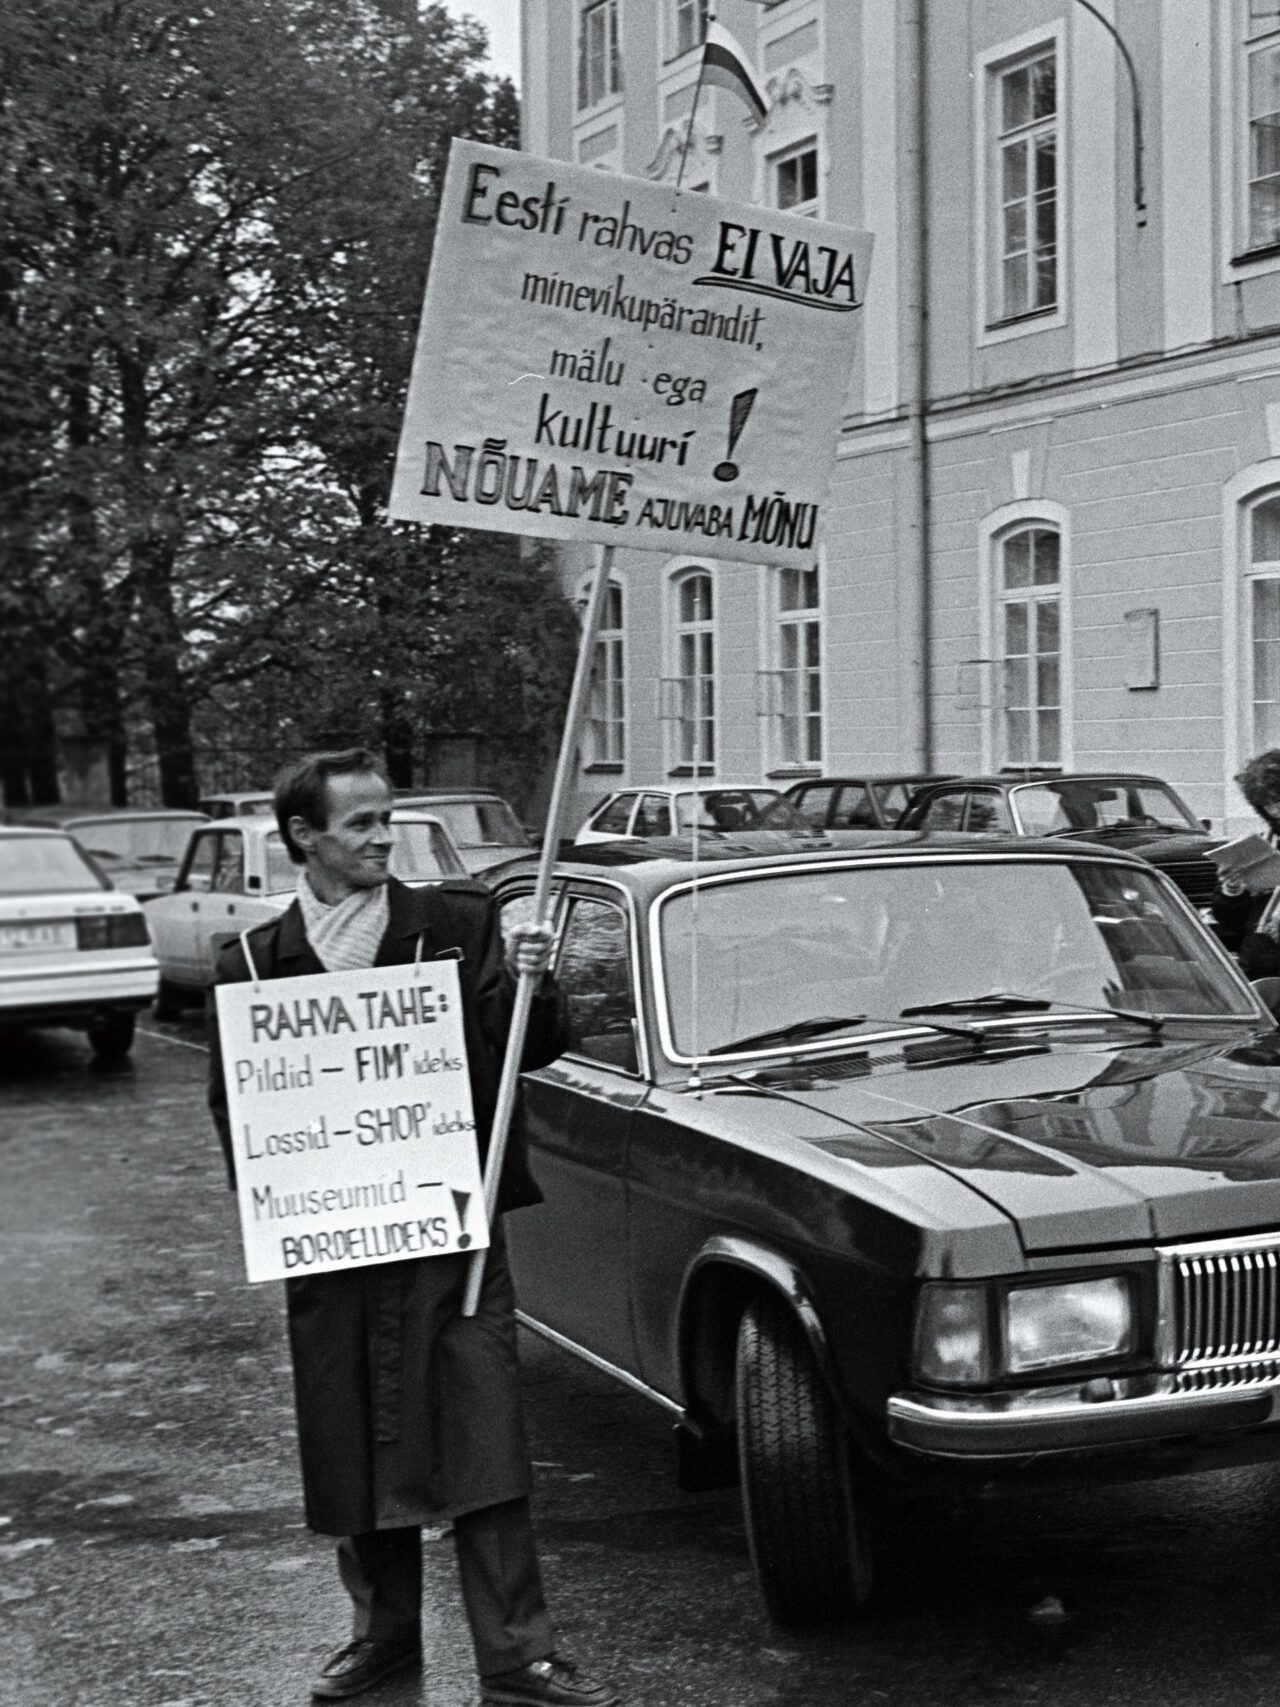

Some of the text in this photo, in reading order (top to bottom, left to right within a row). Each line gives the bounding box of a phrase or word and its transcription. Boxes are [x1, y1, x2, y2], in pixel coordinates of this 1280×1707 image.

[461, 162, 856, 303] Eesti rahvas EI VAJA
[521, 273, 766, 351] minevikupärandit,
[550, 337, 708, 407] mälu ega
[534, 392, 697, 466] kultuuri
[420, 437, 820, 550] NÕUAME AJUVABA MÕNU
[250, 985, 450, 1043] RAHVA TAHE:
[235, 1053, 314, 1095] Pildid
[243, 1115, 330, 1160] Lossid
[251, 1168, 407, 1221] Muuseumid
